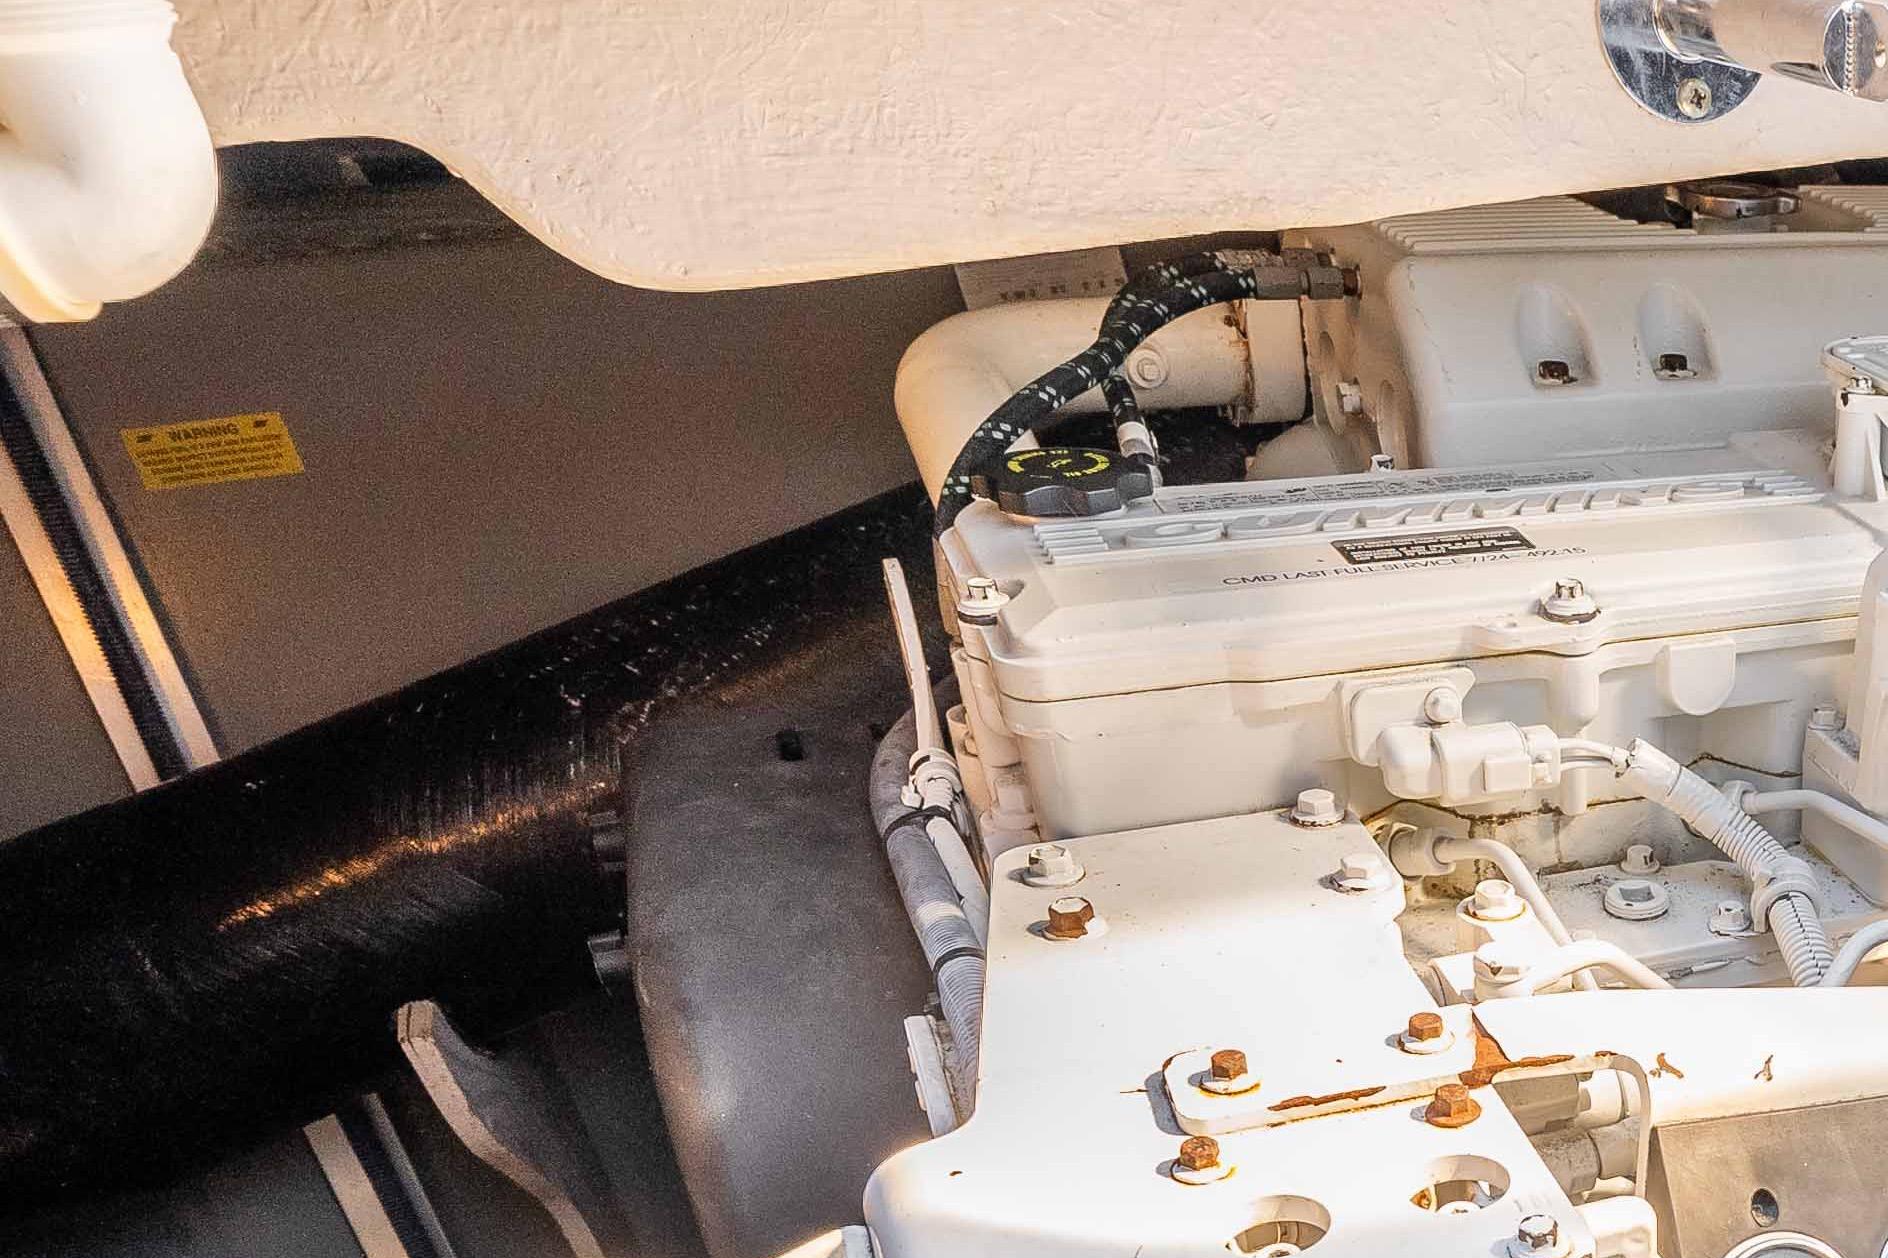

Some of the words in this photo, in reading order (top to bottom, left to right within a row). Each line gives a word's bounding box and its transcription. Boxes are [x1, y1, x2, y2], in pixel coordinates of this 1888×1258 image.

[168, 423, 239, 442] WARNING
[1223, 571, 1278, 586] CMD
[1283, 570, 1327, 580] LAST
[1334, 563, 1373, 576] FULL
[1383, 557, 1459, 572] SERVICE
